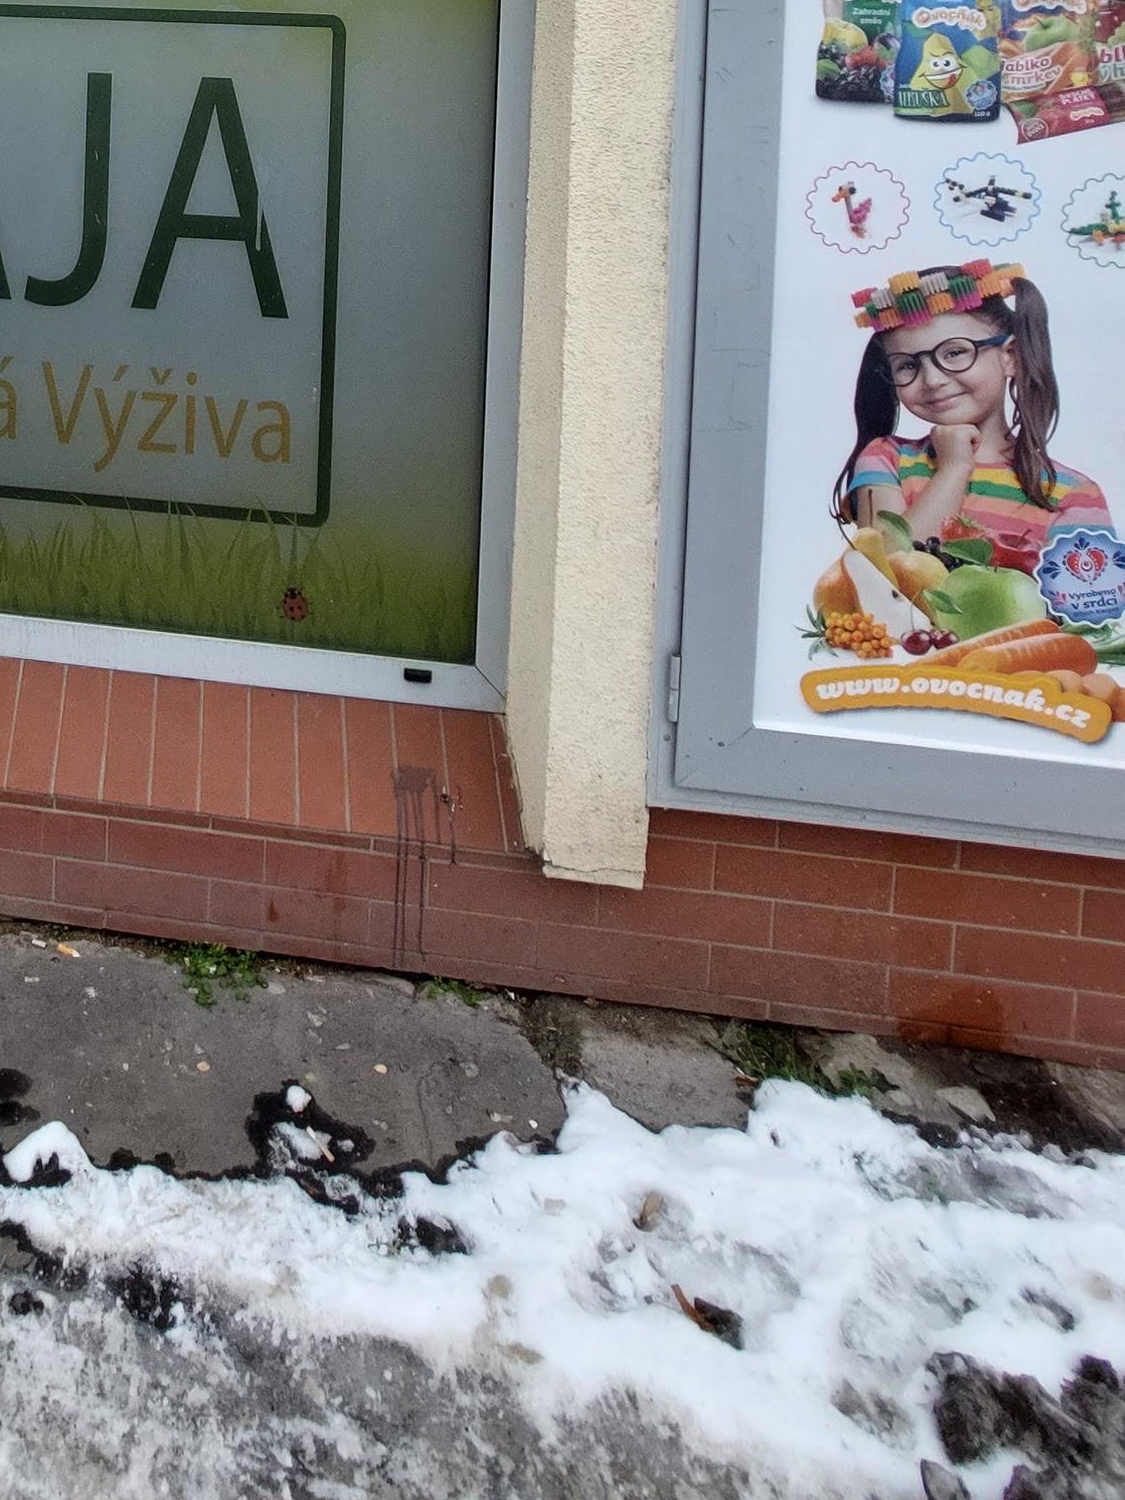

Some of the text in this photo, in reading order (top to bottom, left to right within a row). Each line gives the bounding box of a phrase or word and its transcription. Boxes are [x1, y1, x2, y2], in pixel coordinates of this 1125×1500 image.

[42, 357, 292, 474] Výživa
[1068, 588, 1116, 601] Vyrobeno
[1083, 596, 1118, 609] srdci
